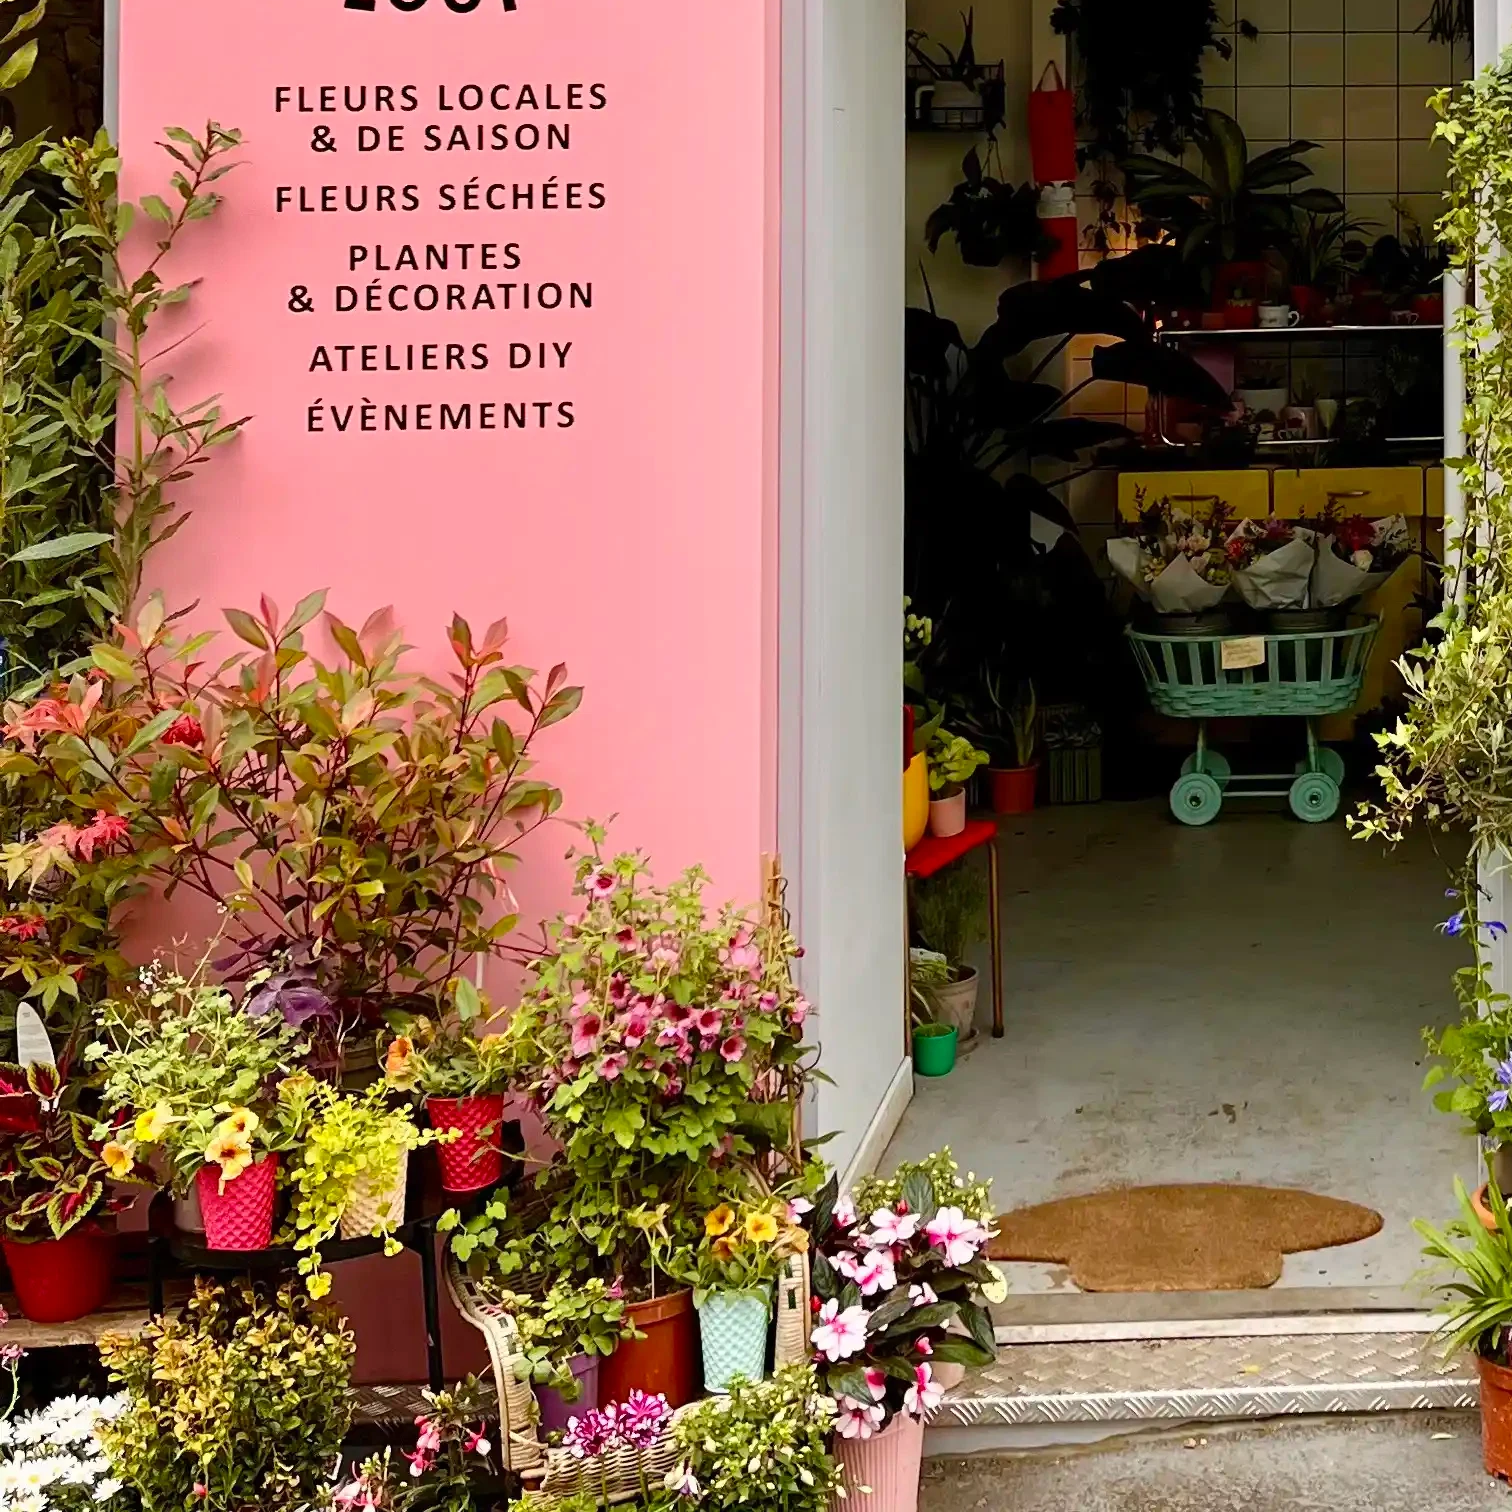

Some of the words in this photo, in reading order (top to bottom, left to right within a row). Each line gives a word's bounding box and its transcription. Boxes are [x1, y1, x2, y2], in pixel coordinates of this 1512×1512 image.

[275, 85, 418, 113] FLEURS
[438, 83, 607, 111] LOCALES
[310, 125, 338, 153] &
[358, 125, 405, 152] DE
[423, 123, 571, 152] SAISON
[275, 185, 419, 213] FLEURS
[438, 176, 606, 211] SÉCHÉES
[349, 242, 521, 272] PLANTES
[287, 284, 315, 313] &
[335, 278, 593, 312] DÉCORATION
[308, 342, 489, 373] ATELIERS
[509, 341, 573, 369] DIY
[307, 397, 576, 433] ÉVÈNEMENTS
